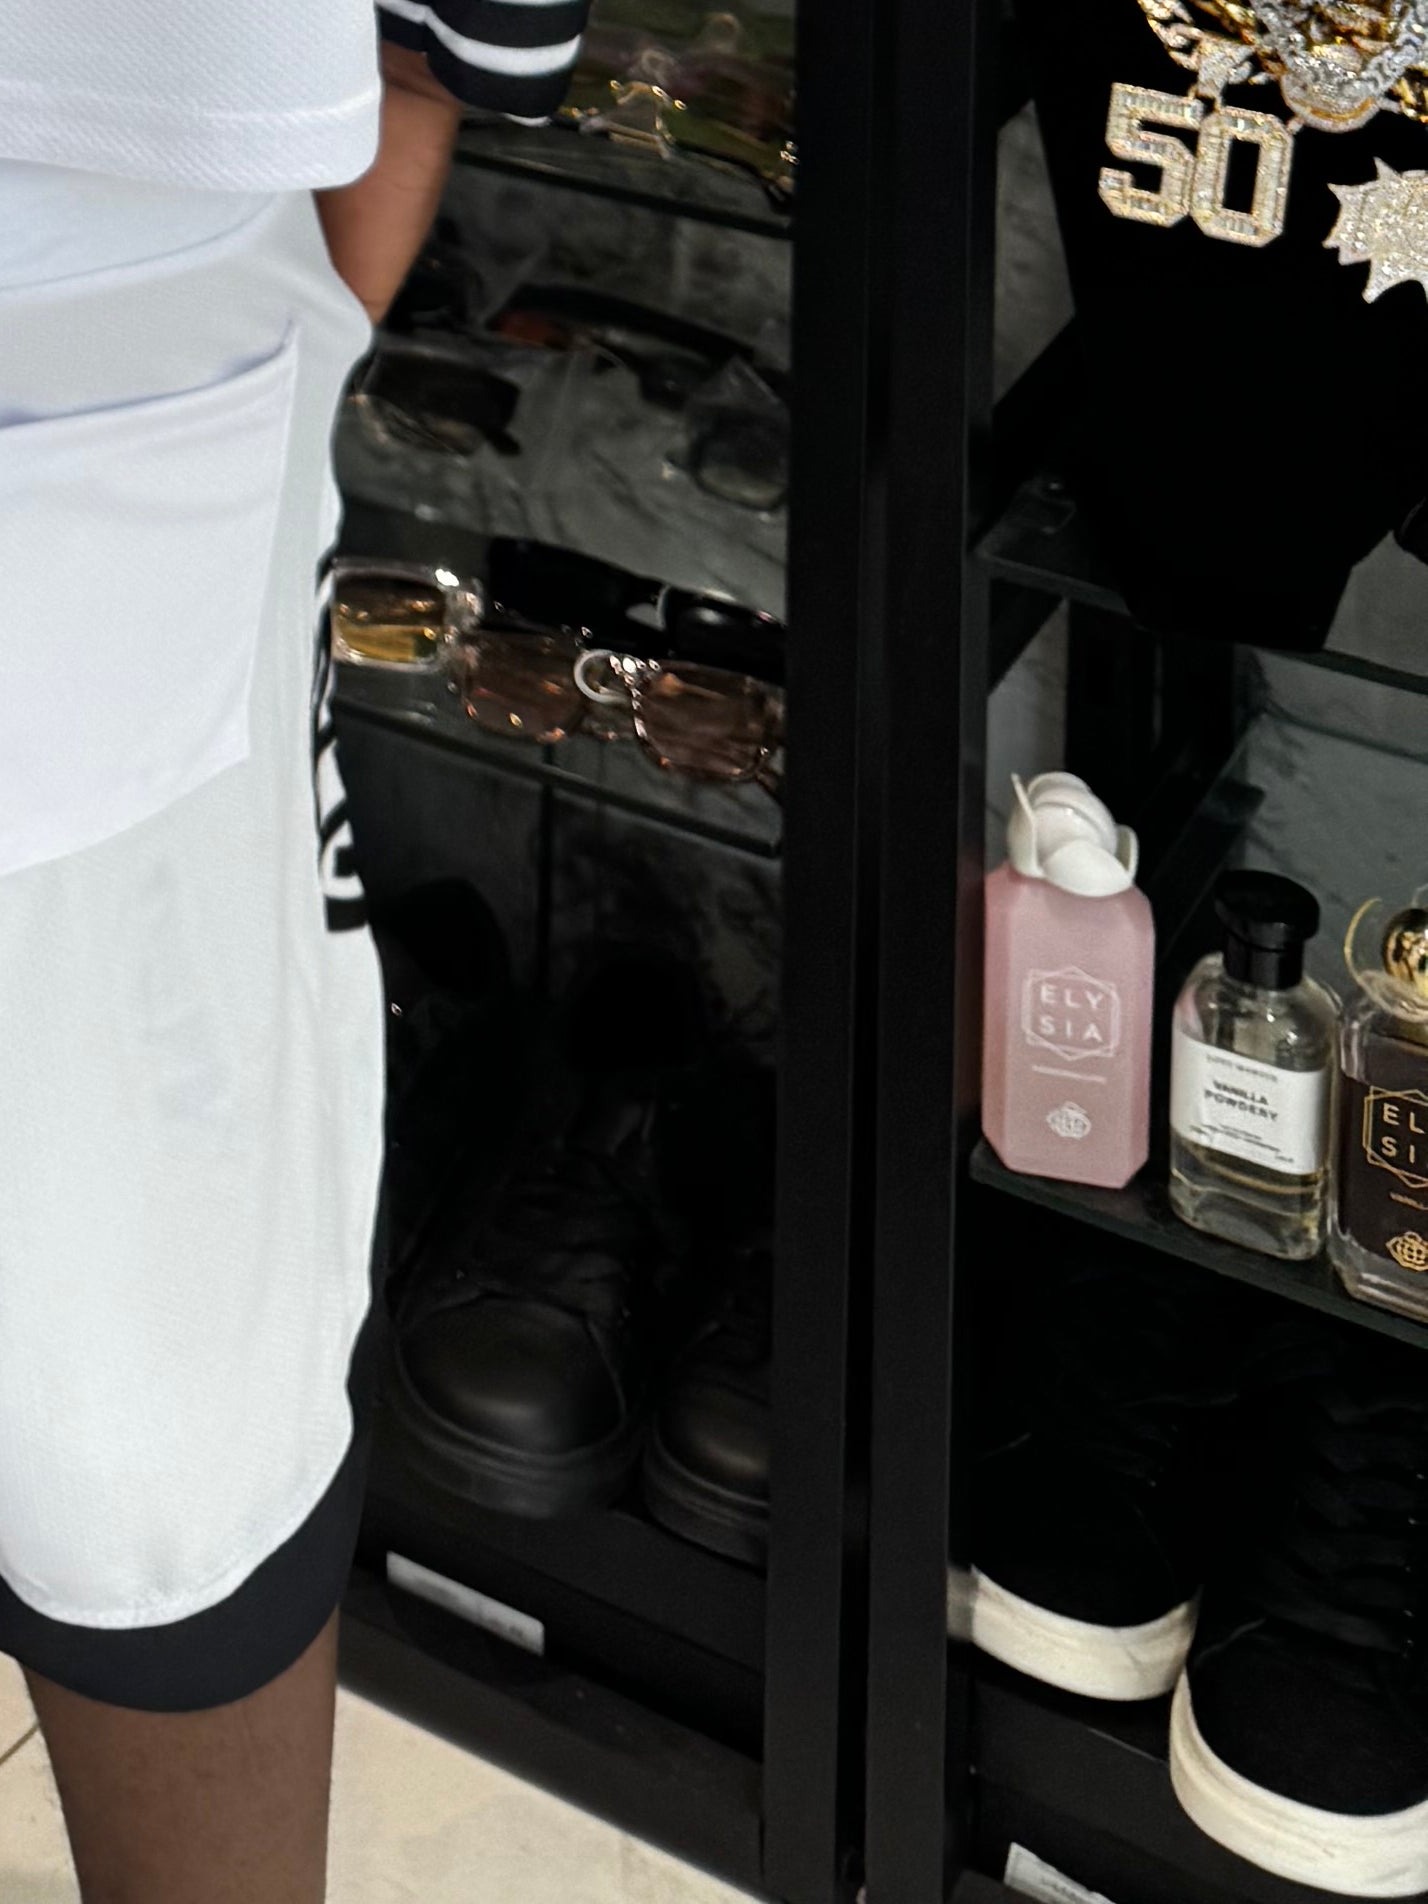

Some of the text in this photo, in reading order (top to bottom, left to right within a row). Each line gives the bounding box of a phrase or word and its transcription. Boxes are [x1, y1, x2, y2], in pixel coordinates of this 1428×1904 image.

[1098, 82, 1294, 248] 50
[1040, 983, 1104, 1009] ELY
[1039, 1014, 1103, 1043] SIA
[1212, 1079, 1269, 1106] VANILLA
[1382, 1101, 1426, 1134] EL
